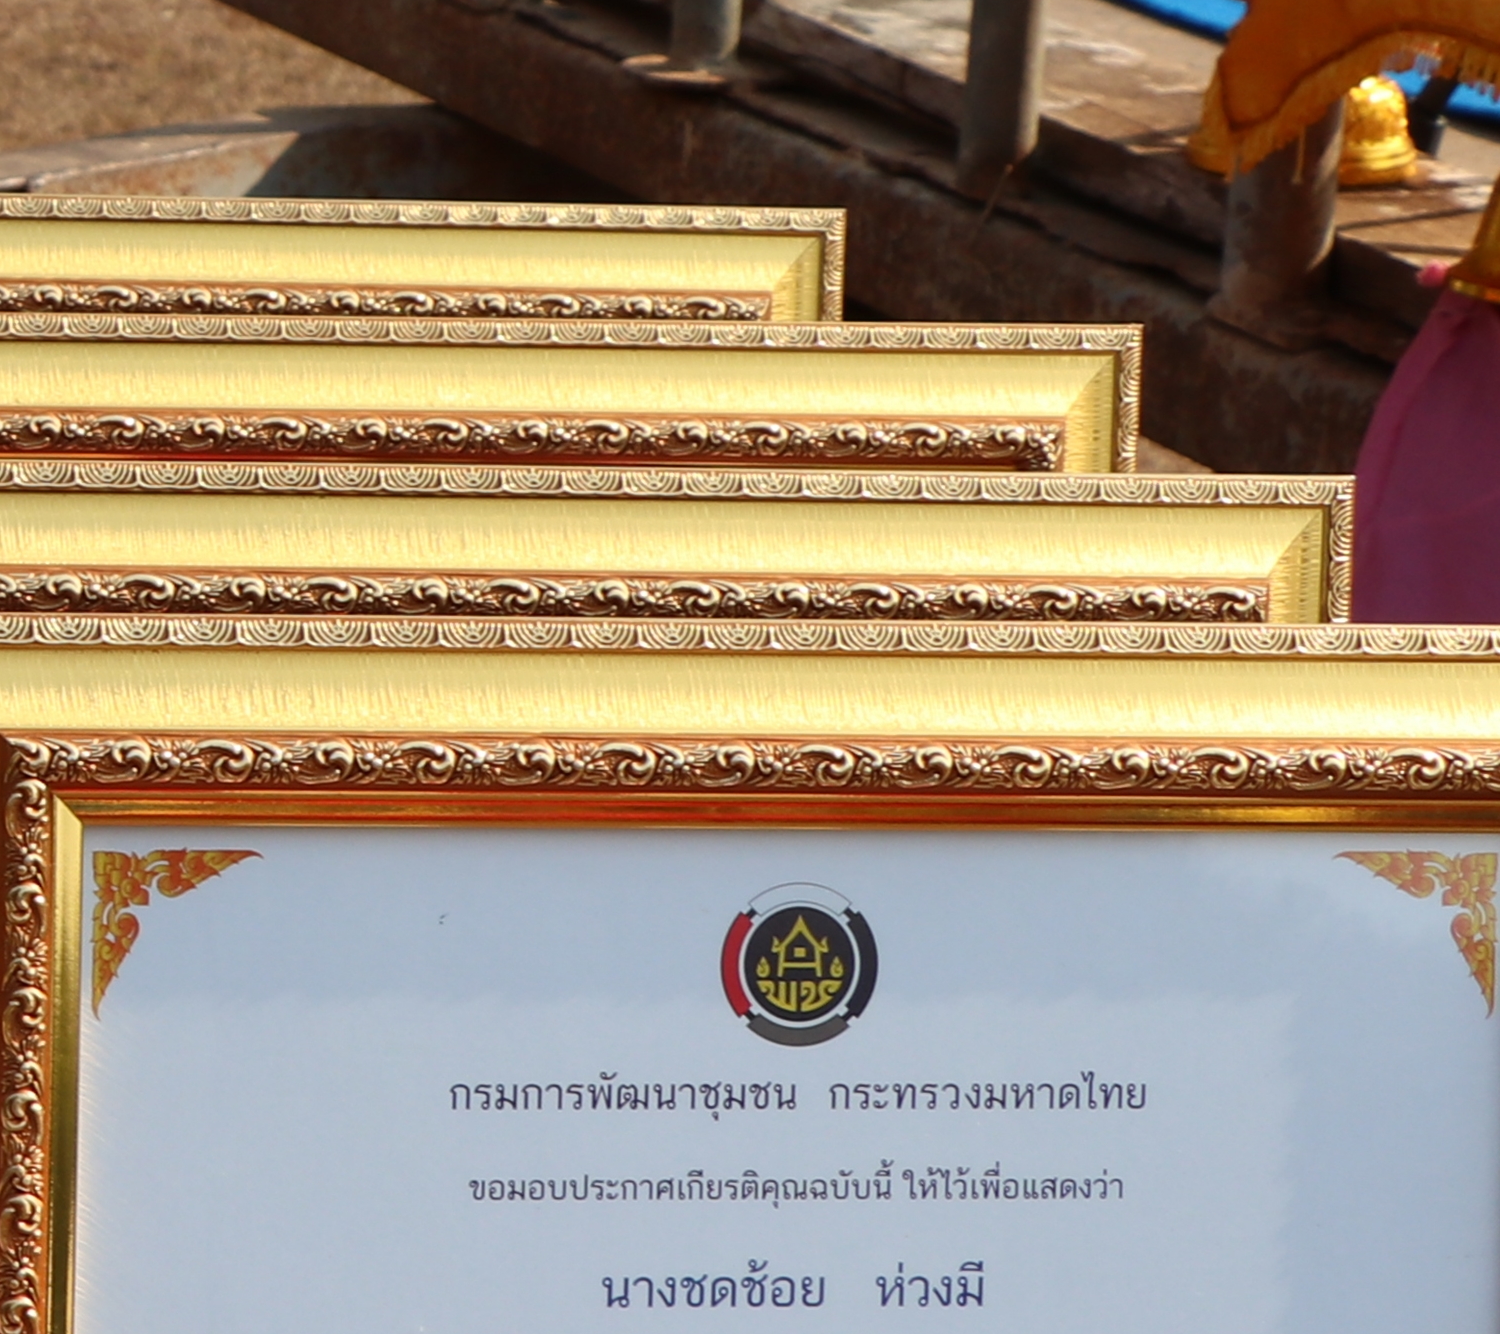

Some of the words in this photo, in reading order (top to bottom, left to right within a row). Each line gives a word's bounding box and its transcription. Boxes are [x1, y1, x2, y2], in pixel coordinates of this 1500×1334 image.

[449, 1071, 797, 1122] กรมการพัฒนาชุมชน
[828, 1070, 1147, 1111] กระทรวงมหาดไทย
[901, 1160, 1124, 1201] ให้ไว้เพื่อแสดงว่า
[601, 1258, 826, 1309] นางชดช้อย
[875, 1260, 985, 1308] ห่วงมี
